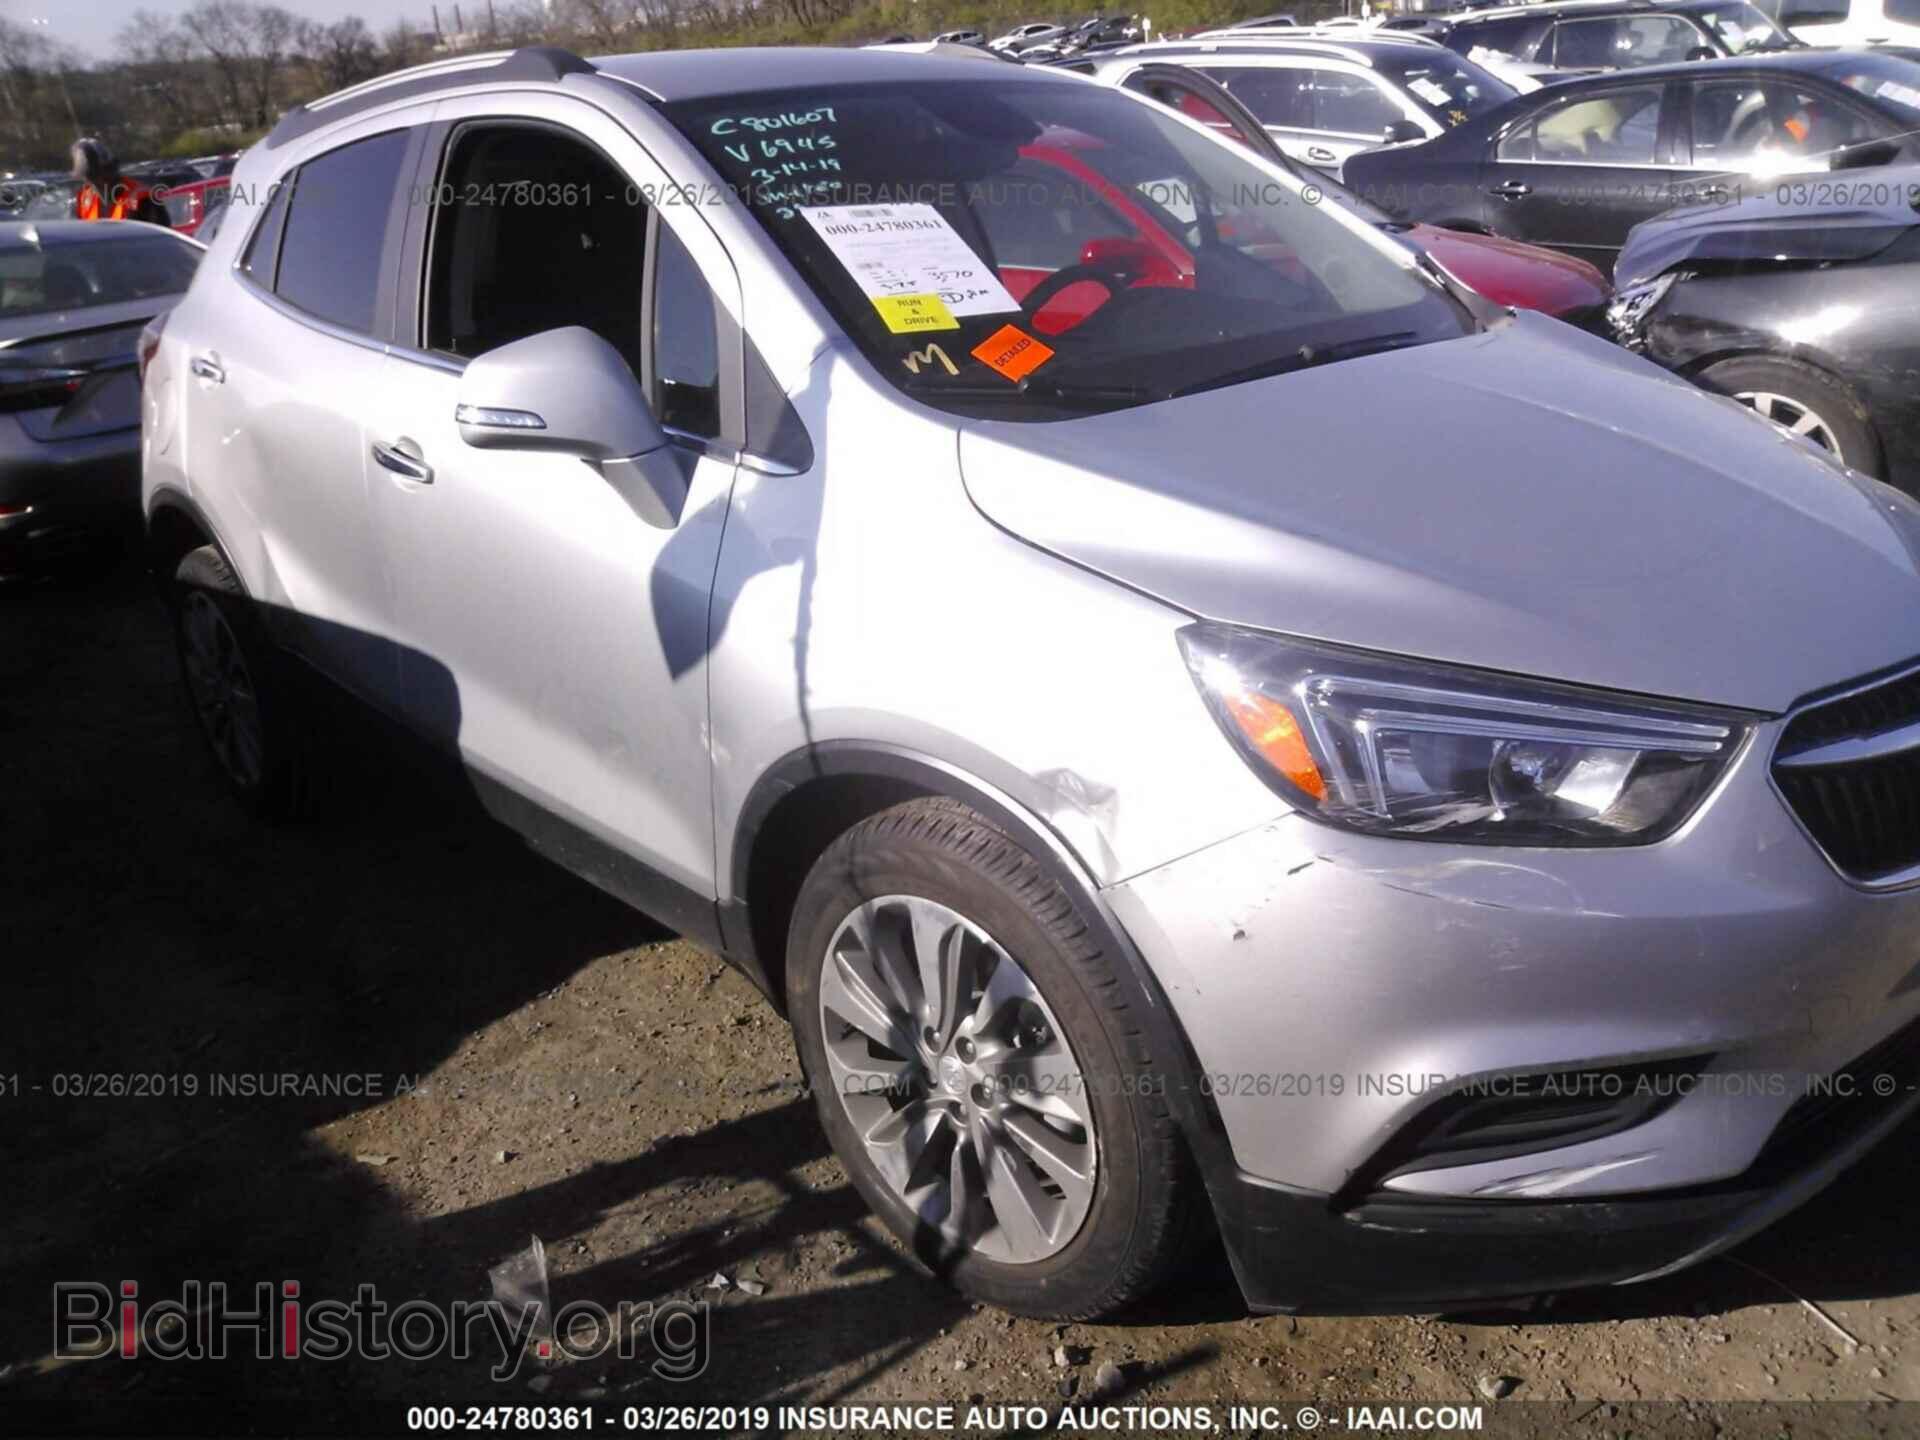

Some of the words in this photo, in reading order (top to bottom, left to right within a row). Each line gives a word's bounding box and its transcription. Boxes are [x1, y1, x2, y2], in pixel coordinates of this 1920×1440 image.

[825, 219, 943, 236] 000-24780361
[897, 299, 922, 307] RUN
[903, 314, 938, 325] DRIVE
[993, 337, 1032, 367] DETAILED
